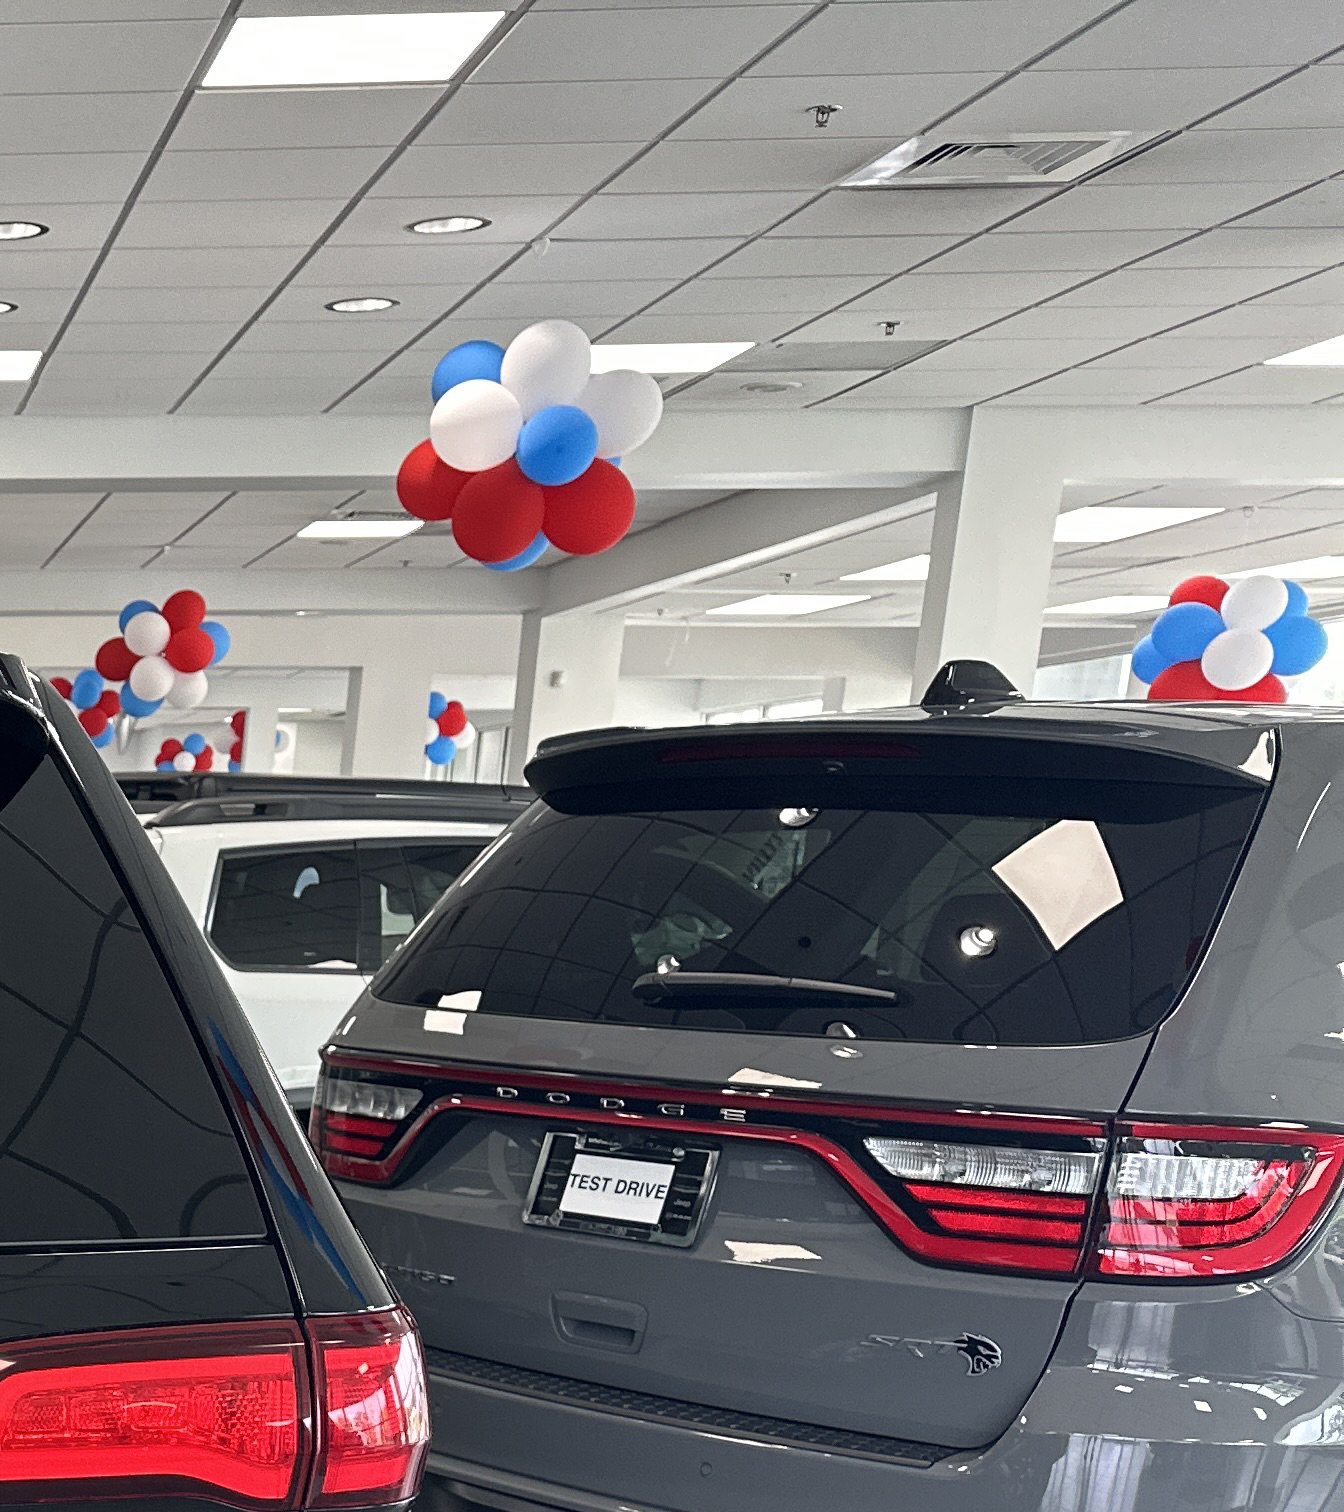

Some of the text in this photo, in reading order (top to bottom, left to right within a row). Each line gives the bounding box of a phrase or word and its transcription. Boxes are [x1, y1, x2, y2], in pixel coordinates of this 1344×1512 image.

[496, 1086, 747, 1123] DODGE
[570, 1173, 668, 1200] TEST DRIVE
